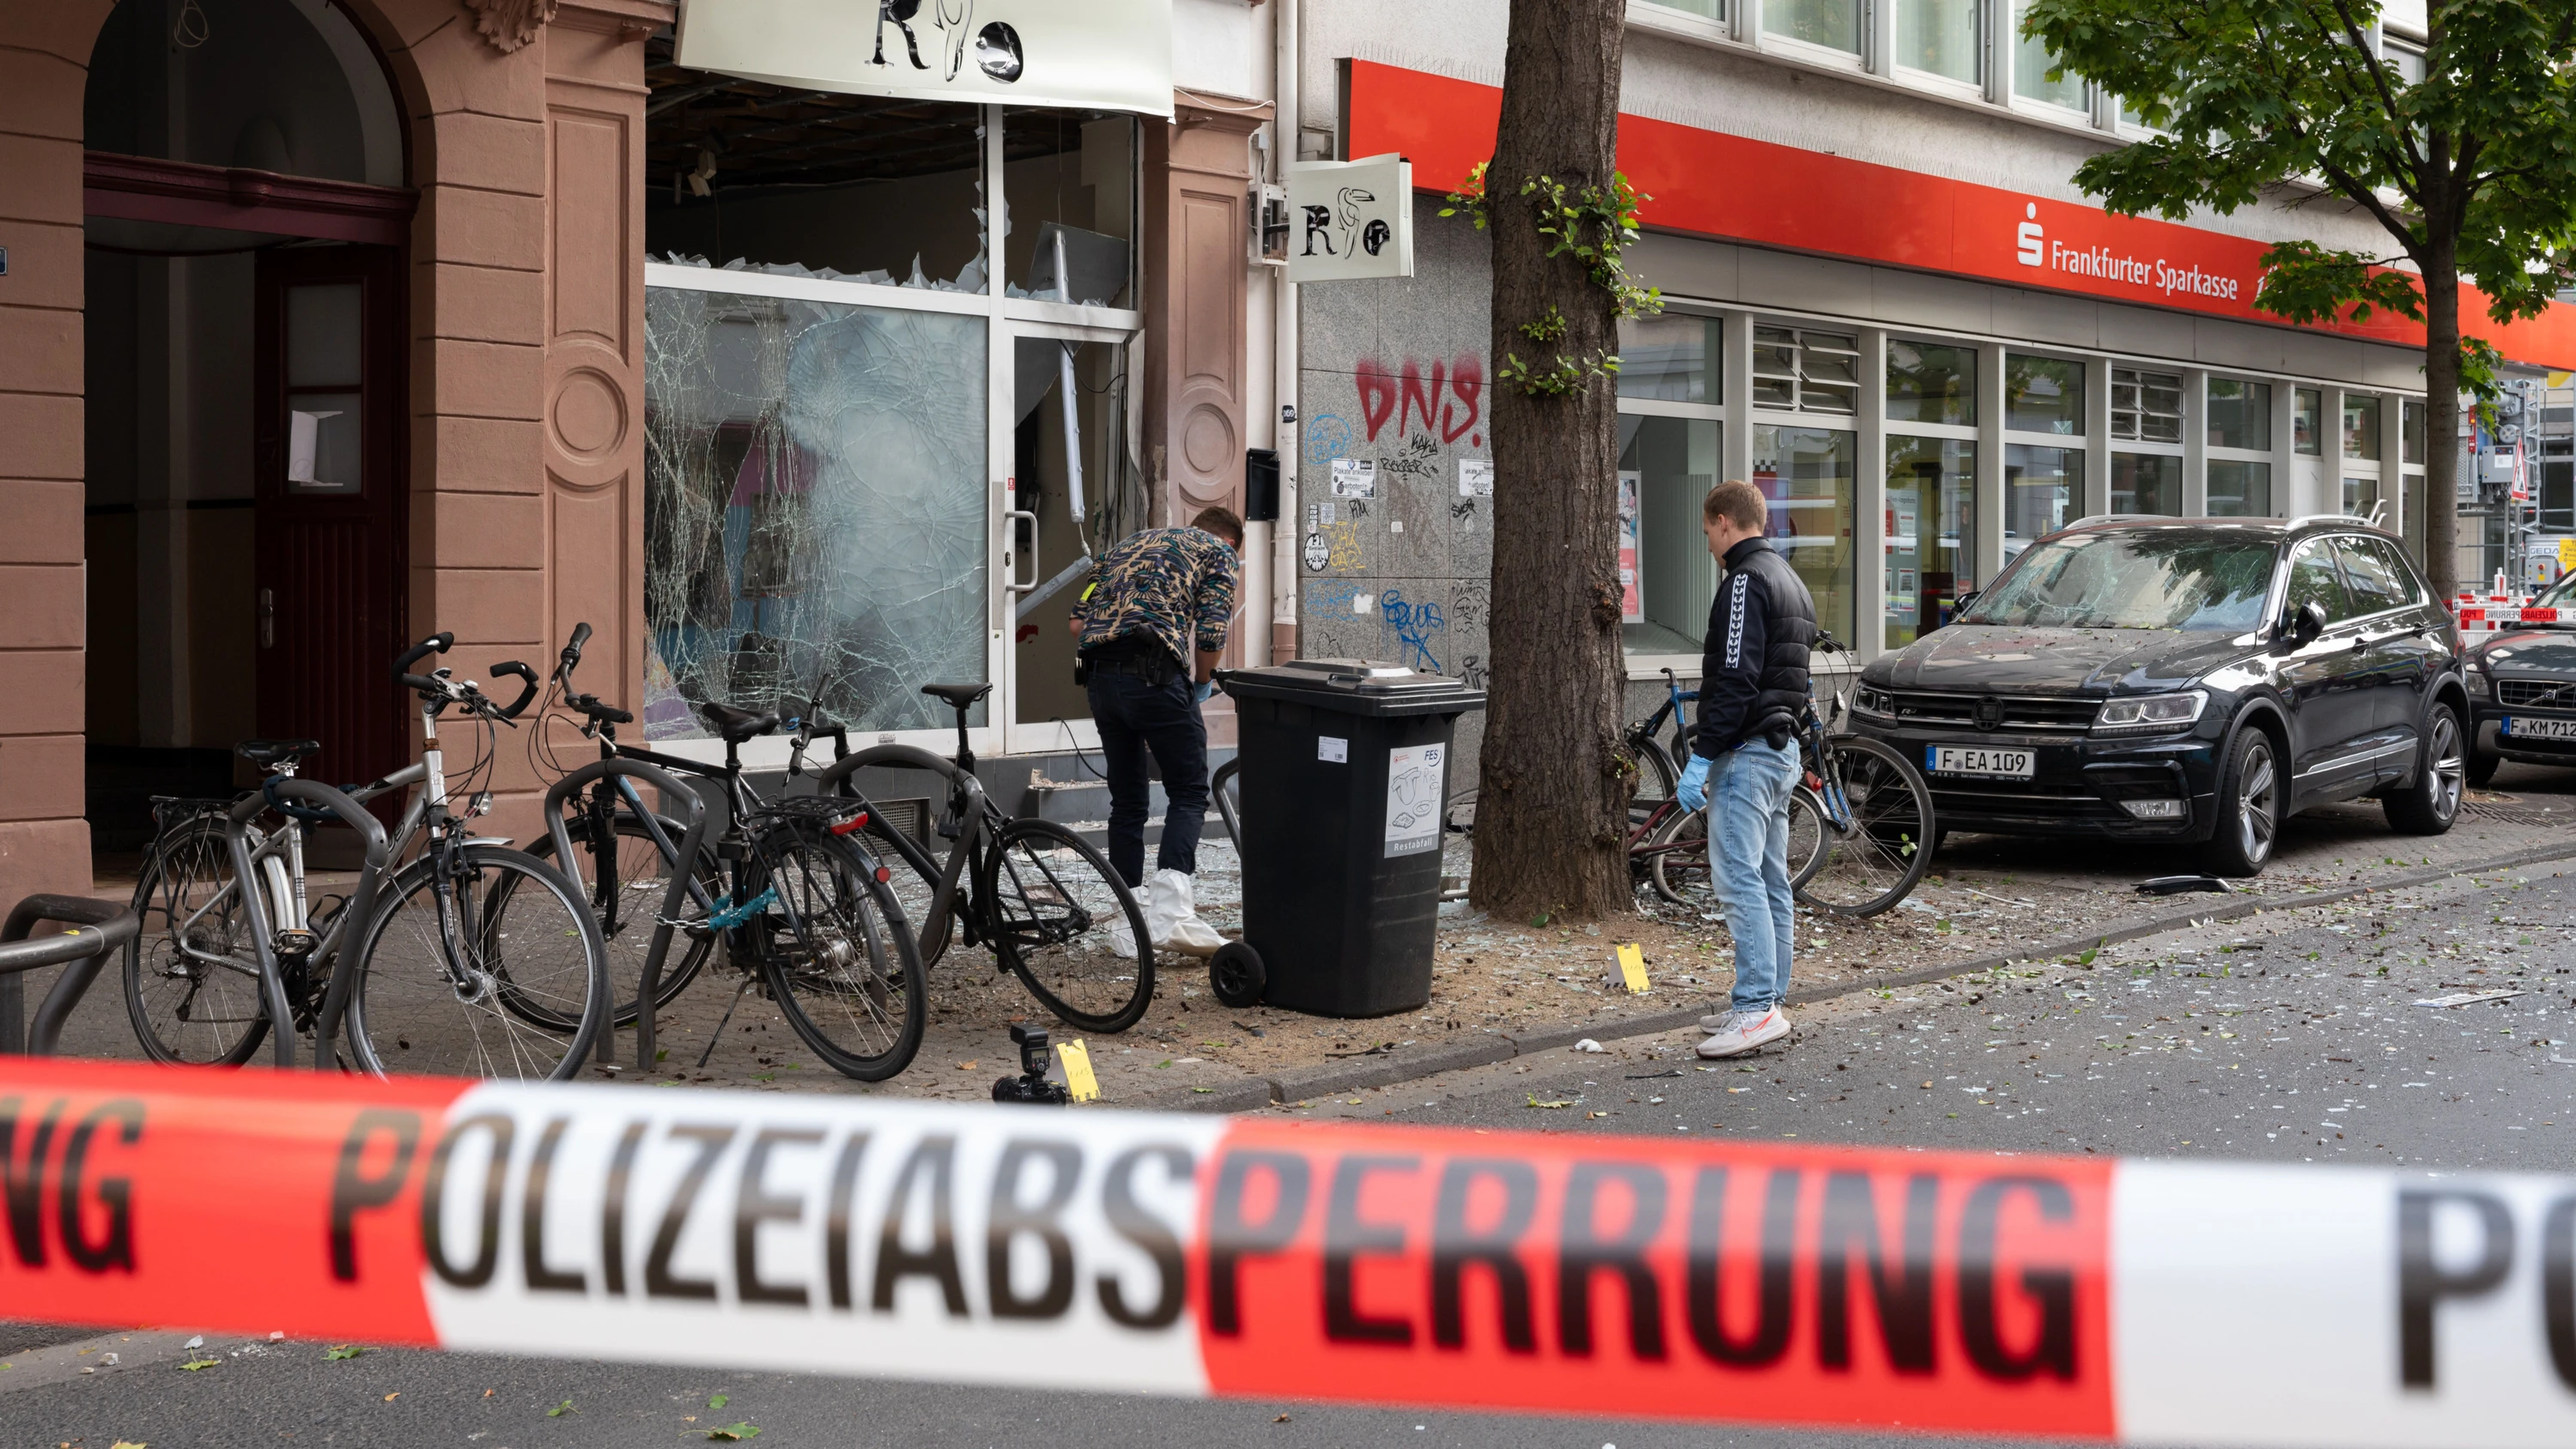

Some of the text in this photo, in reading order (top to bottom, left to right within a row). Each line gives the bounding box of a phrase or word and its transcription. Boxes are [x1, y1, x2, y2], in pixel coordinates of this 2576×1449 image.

[2052, 240, 2152, 285] Frankfurter
[2156, 259, 2238, 300] Sparkasse
[2511, 719, 2520, 732] F
[2530, 720, 2548, 735] KM
[1425, 749, 1439, 761] FES
[1942, 750, 2026, 772] F EA 109
[1394, 837, 1432, 852] Restabfall
[331, 1106, 2075, 1385] POLIZEIABSPERRUNG
